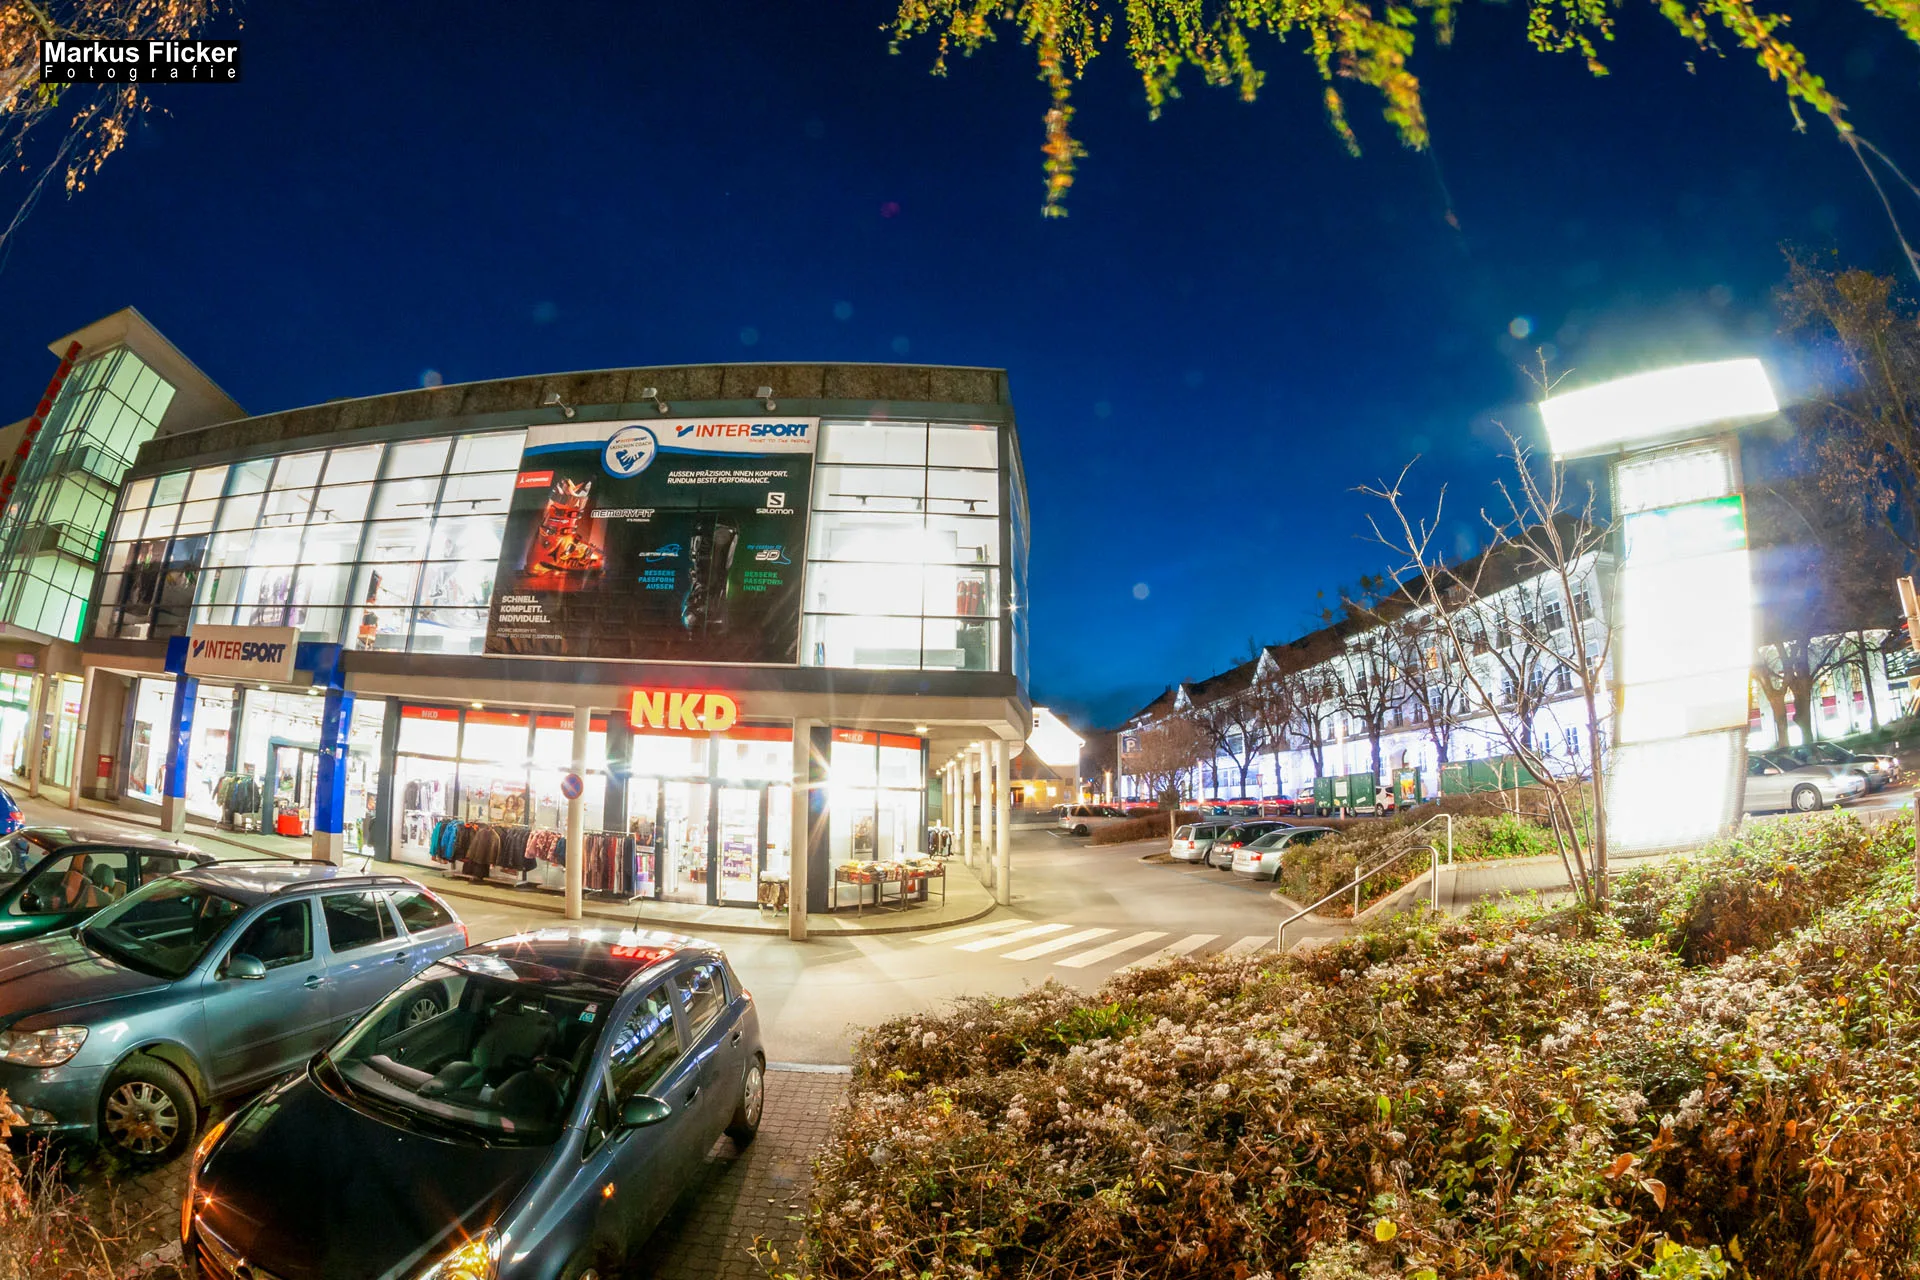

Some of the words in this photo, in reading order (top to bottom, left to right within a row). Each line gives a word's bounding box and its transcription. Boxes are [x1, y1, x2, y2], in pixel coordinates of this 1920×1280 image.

[695, 423, 809, 437] INTERSPORT
[500, 605, 543, 613] KOMPLETT.
[499, 614, 550, 623] INDIVIDUELL.
[204, 640, 286, 663] INTERSPORT
[631, 690, 737, 731] NKD
